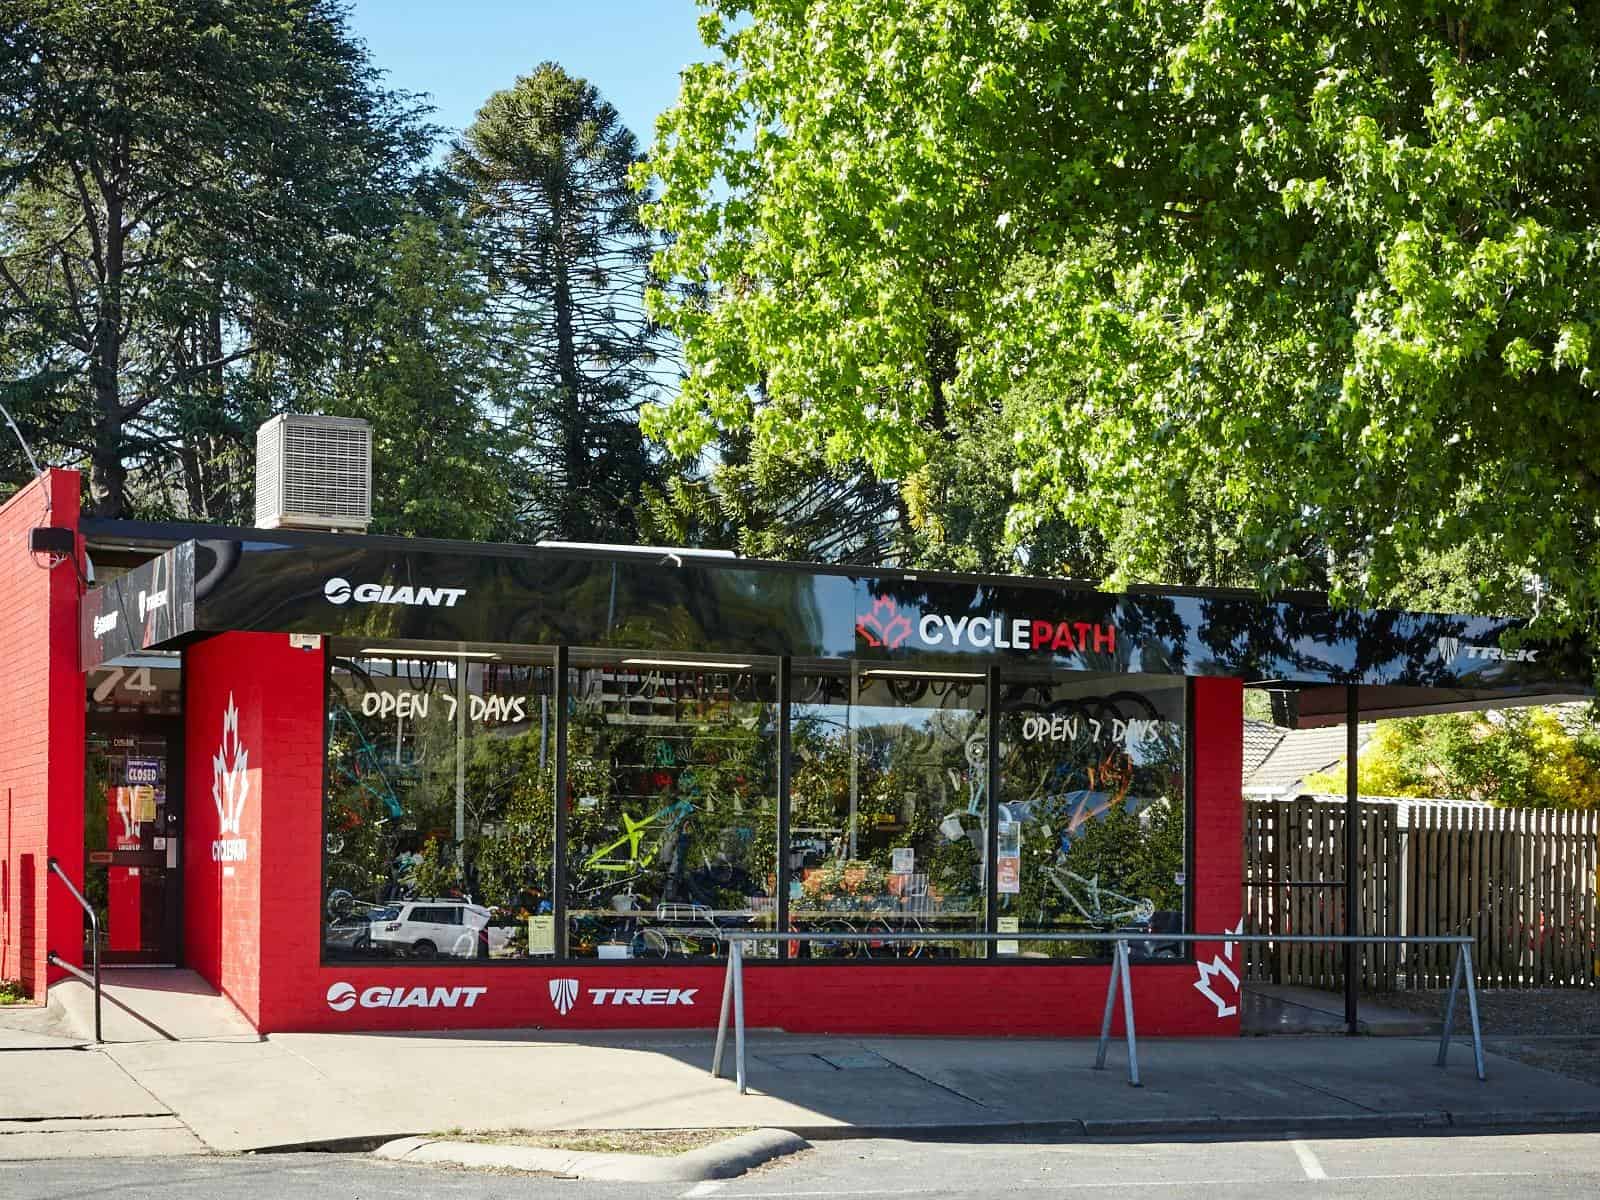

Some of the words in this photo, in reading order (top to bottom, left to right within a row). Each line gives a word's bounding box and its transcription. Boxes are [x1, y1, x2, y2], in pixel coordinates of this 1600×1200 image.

[353, 583, 467, 607] GIANT
[918, 614, 1116, 654] CYCLEPATH
[93, 667, 157, 702] 74
[361, 691, 429, 720] OPEN
[442, 693, 458, 722] 7
[469, 693, 526, 723] DAYS
[1022, 716, 1078, 742] OPEN
[1088, 717, 1101, 744] 7
[1111, 717, 1161, 744] DAYS
[128, 768, 157, 781] CLOSED
[211, 838, 248, 864] CYCLE
[360, 986, 488, 1008] GIANT
[587, 988, 699, 1006] TREK
